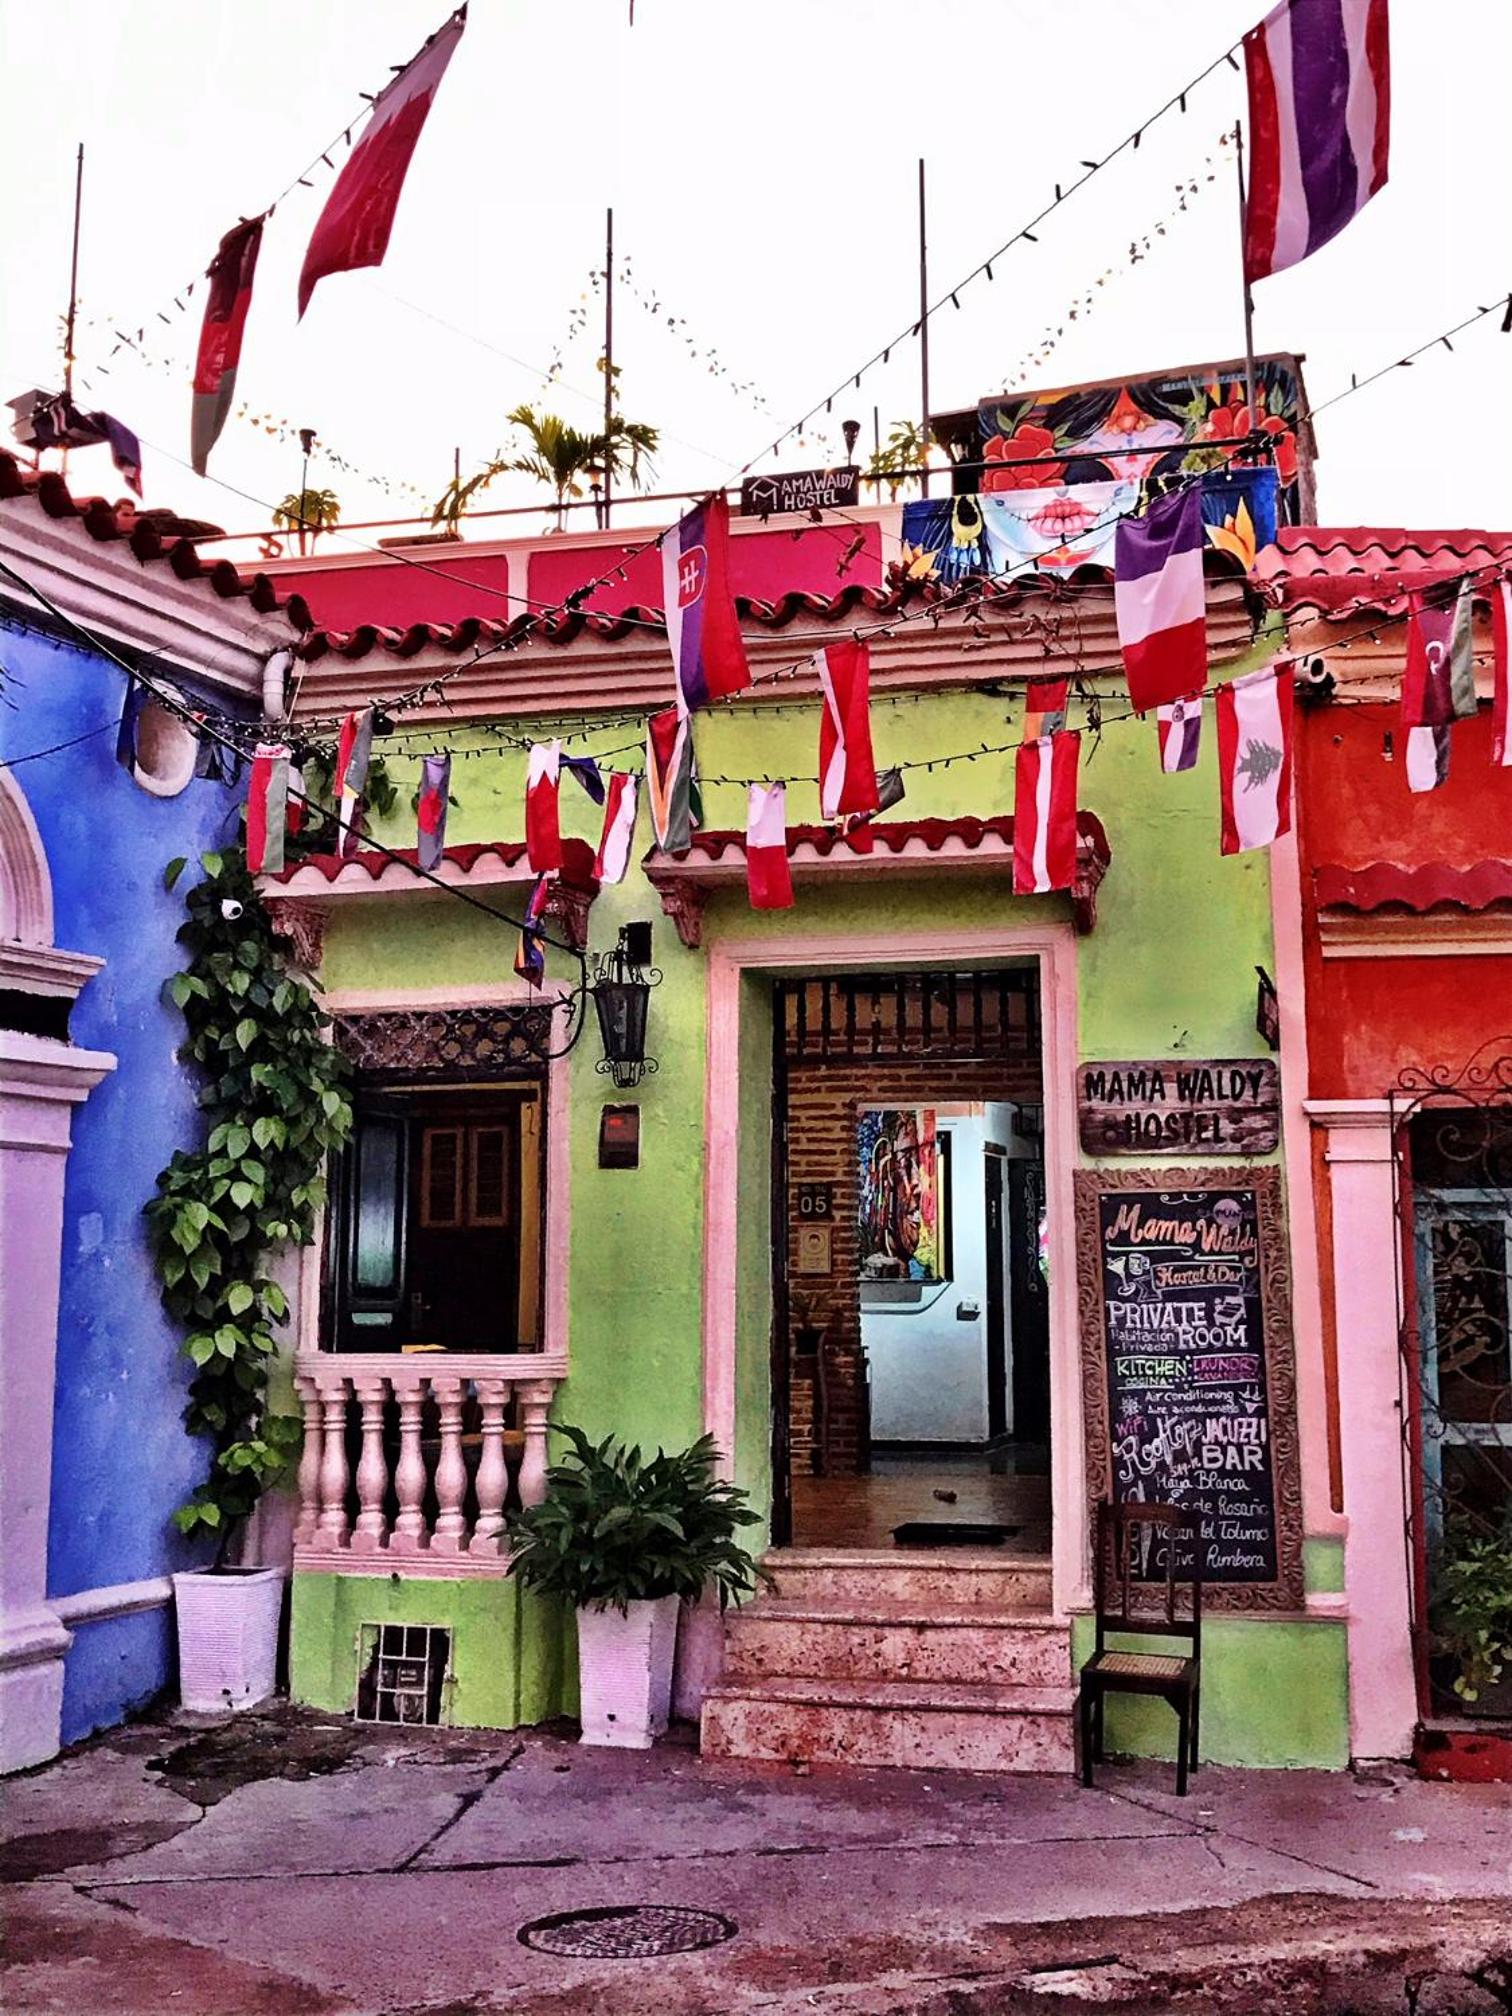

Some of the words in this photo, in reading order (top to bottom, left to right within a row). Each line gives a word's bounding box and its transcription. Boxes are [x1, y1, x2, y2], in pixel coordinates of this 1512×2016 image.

[784, 489, 840, 511] HOSTEL
[1085, 1070, 1166, 1103] MAMA
[1176, 1068, 1265, 1104] WALDY
[1124, 1111, 1227, 1145] HOSTEL
[801, 1196, 827, 1213] 05
[1105, 1203, 1197, 1244] Mama
[1196, 1218, 1258, 1268] Waldy
[1105, 1301, 1208, 1330] PRIVATE
[1177, 1325, 1249, 1350] ROOM
[1117, 1360, 1187, 1377] KITCHEN
[1194, 1357, 1259, 1373] LAUNDRY
[1145, 1391, 1163, 1402] Air
[1164, 1389, 1235, 1408] conditioning
[1202, 1416, 1267, 1446] JACUZZI
[1202, 1446, 1265, 1472] BAR
[1194, 1470, 1250, 1491] Blanca
